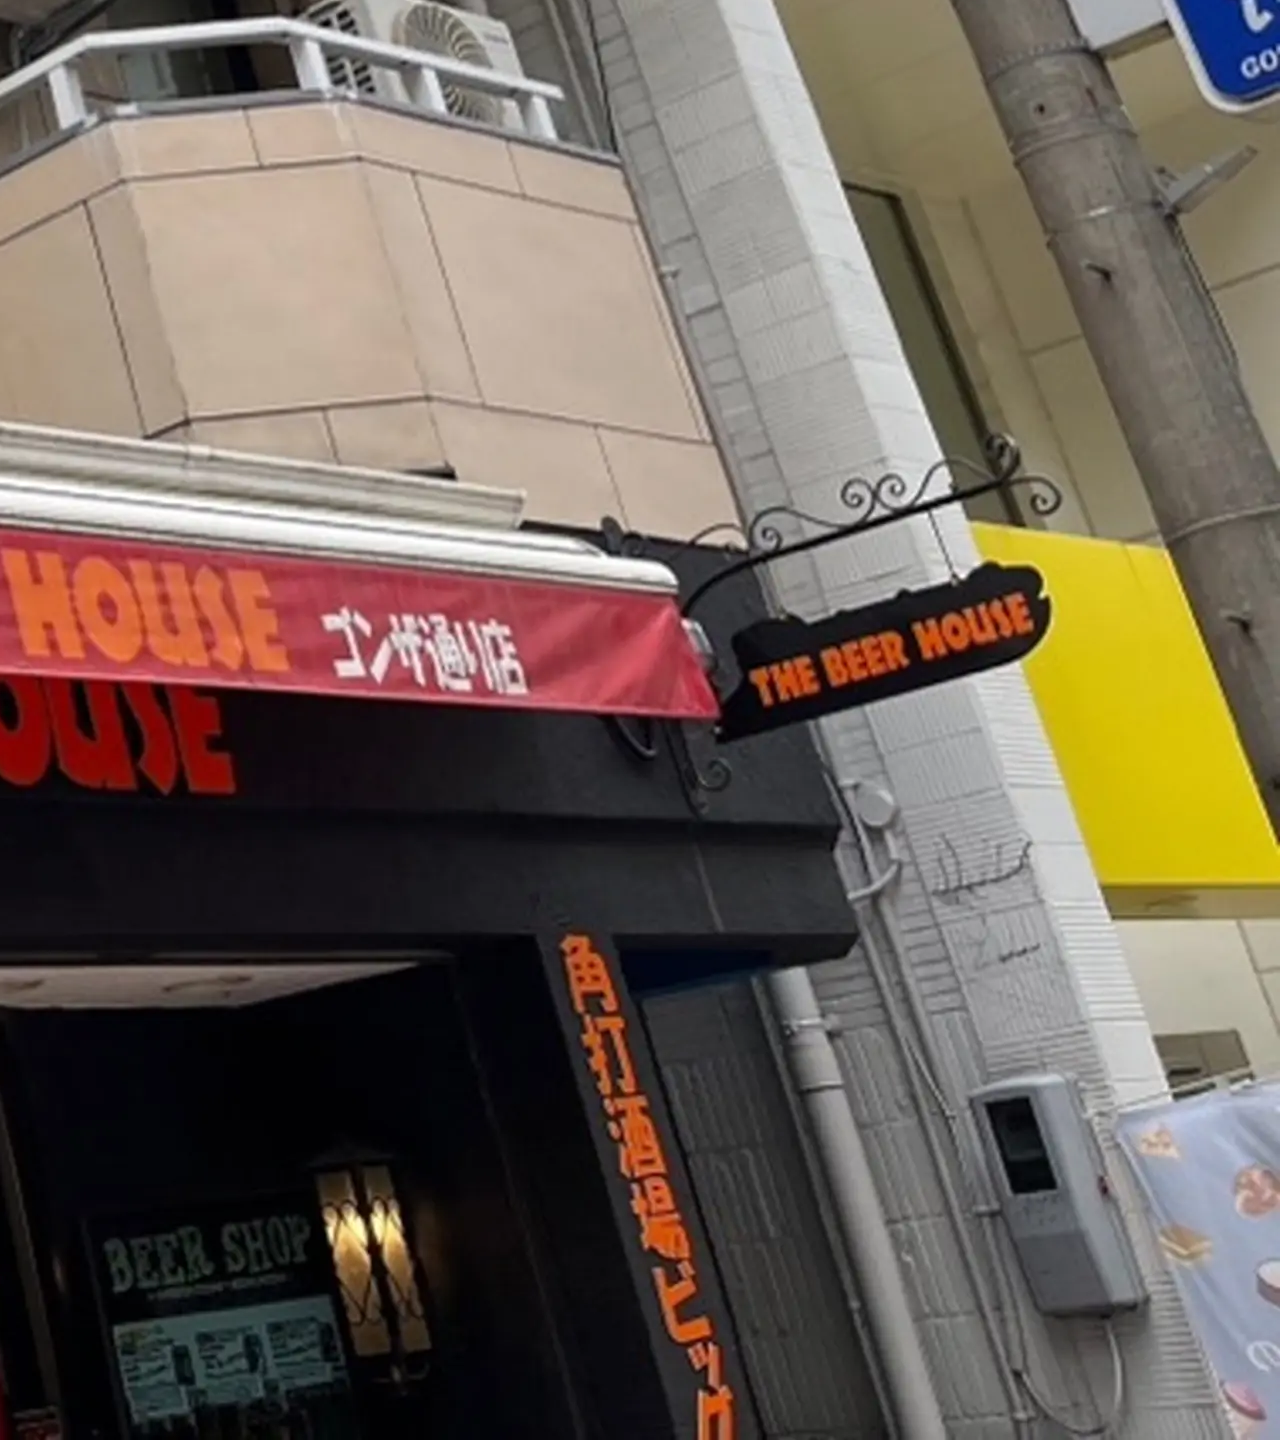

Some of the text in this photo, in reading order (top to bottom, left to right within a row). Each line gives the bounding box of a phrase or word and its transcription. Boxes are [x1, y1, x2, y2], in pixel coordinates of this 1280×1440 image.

[1240, 45, 1280, 80] GO
[0, 546, 292, 673] HOUSE
[321, 606, 531, 696] ゴンザ通り店
[749, 591, 1035, 709] THE BEER HOUSE
[103, 1224, 216, 1295] BEER
[220, 1212, 313, 1275] SHOP
